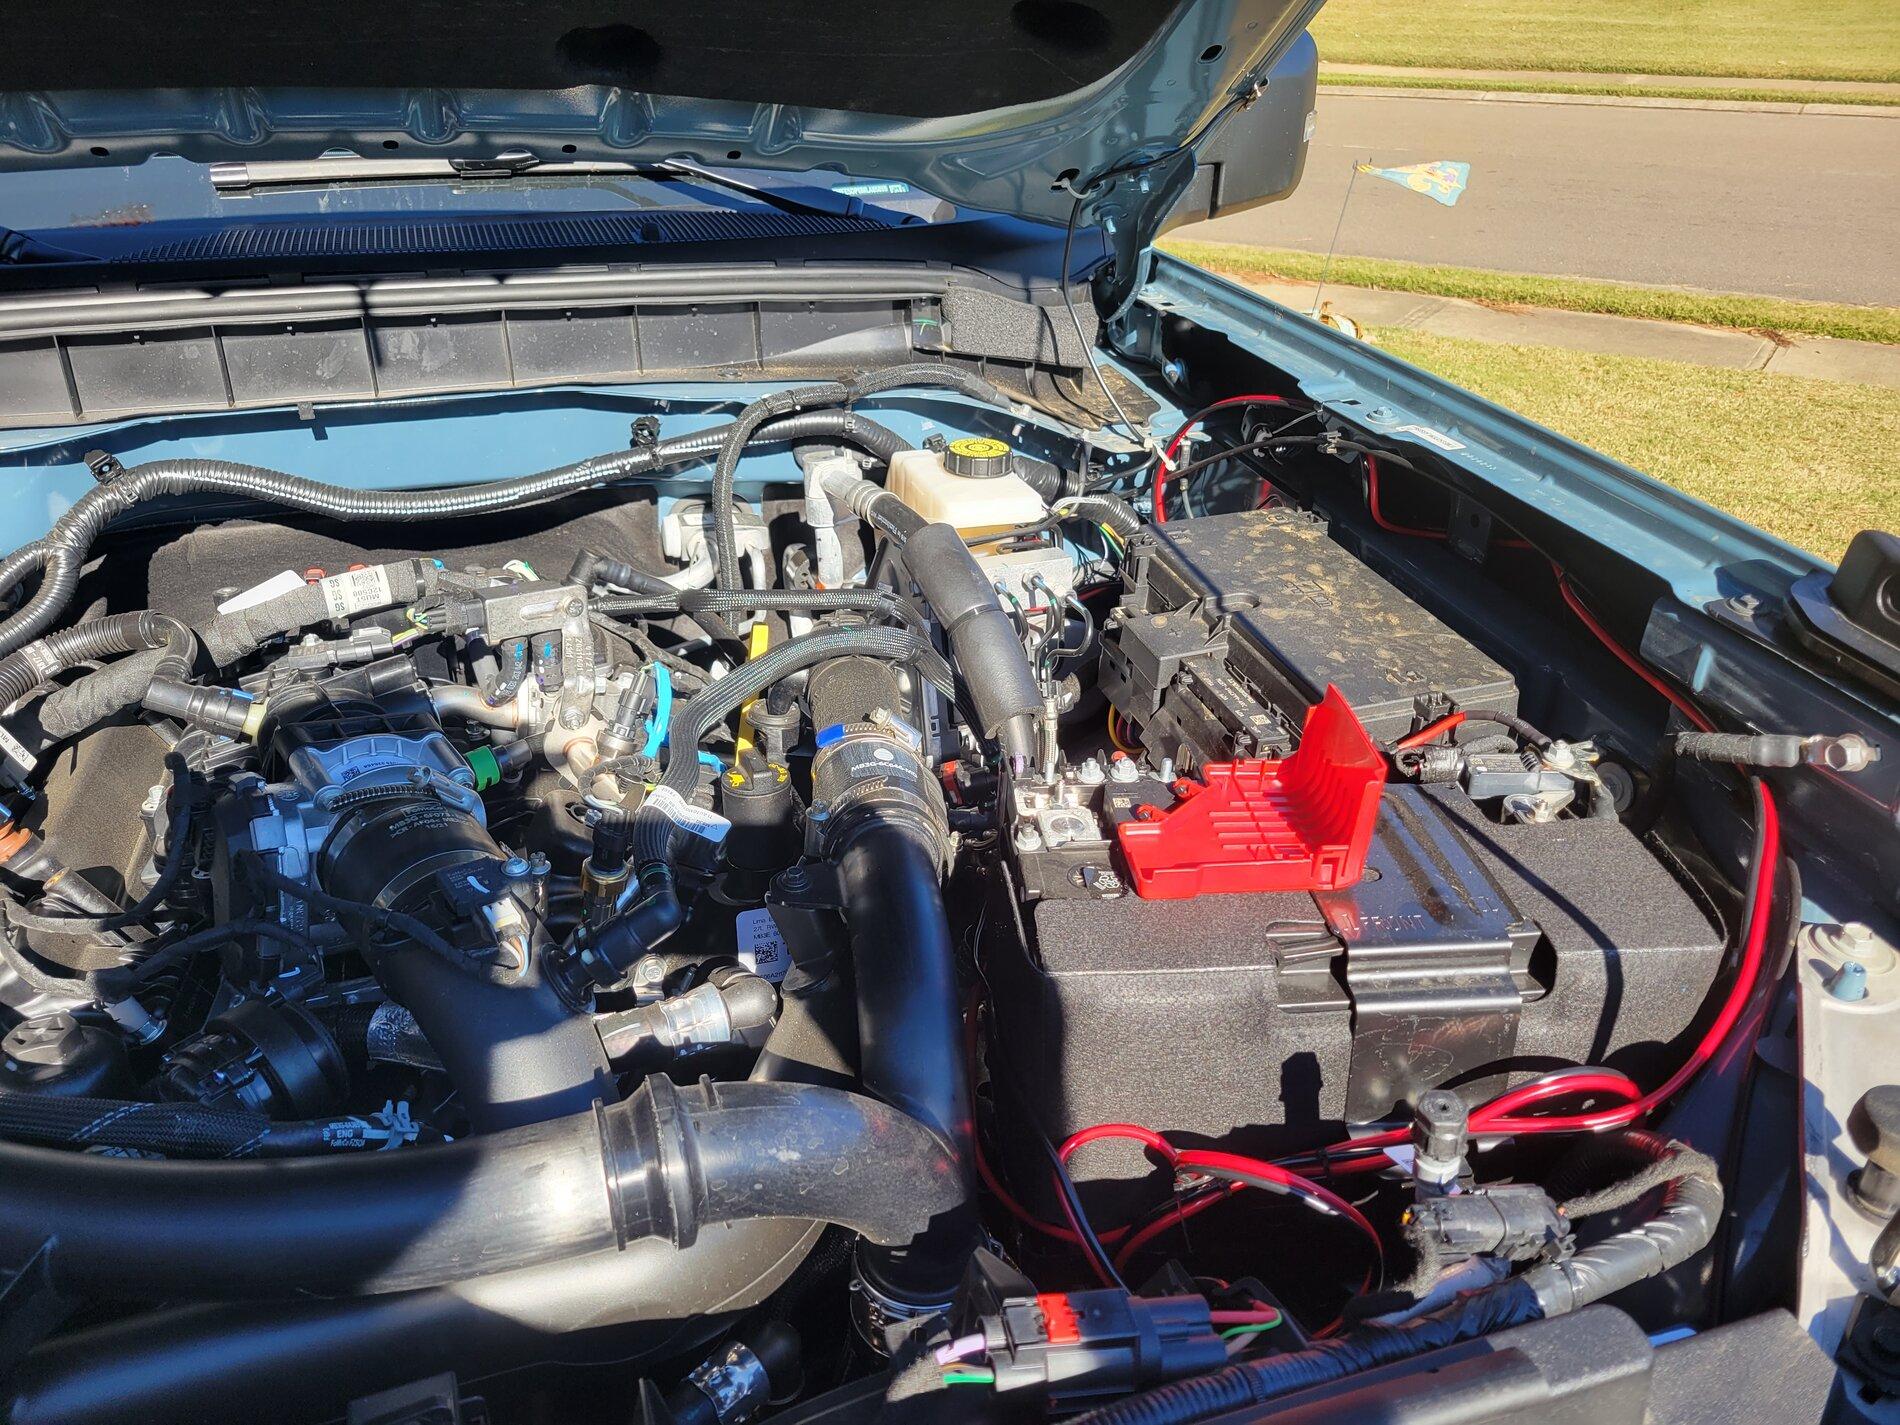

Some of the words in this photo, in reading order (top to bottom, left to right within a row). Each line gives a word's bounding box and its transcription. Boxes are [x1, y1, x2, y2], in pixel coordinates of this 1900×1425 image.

[329, 578, 340, 588] SG
[334, 602, 345, 612] SG
[336, 1129, 354, 1139] ENG
